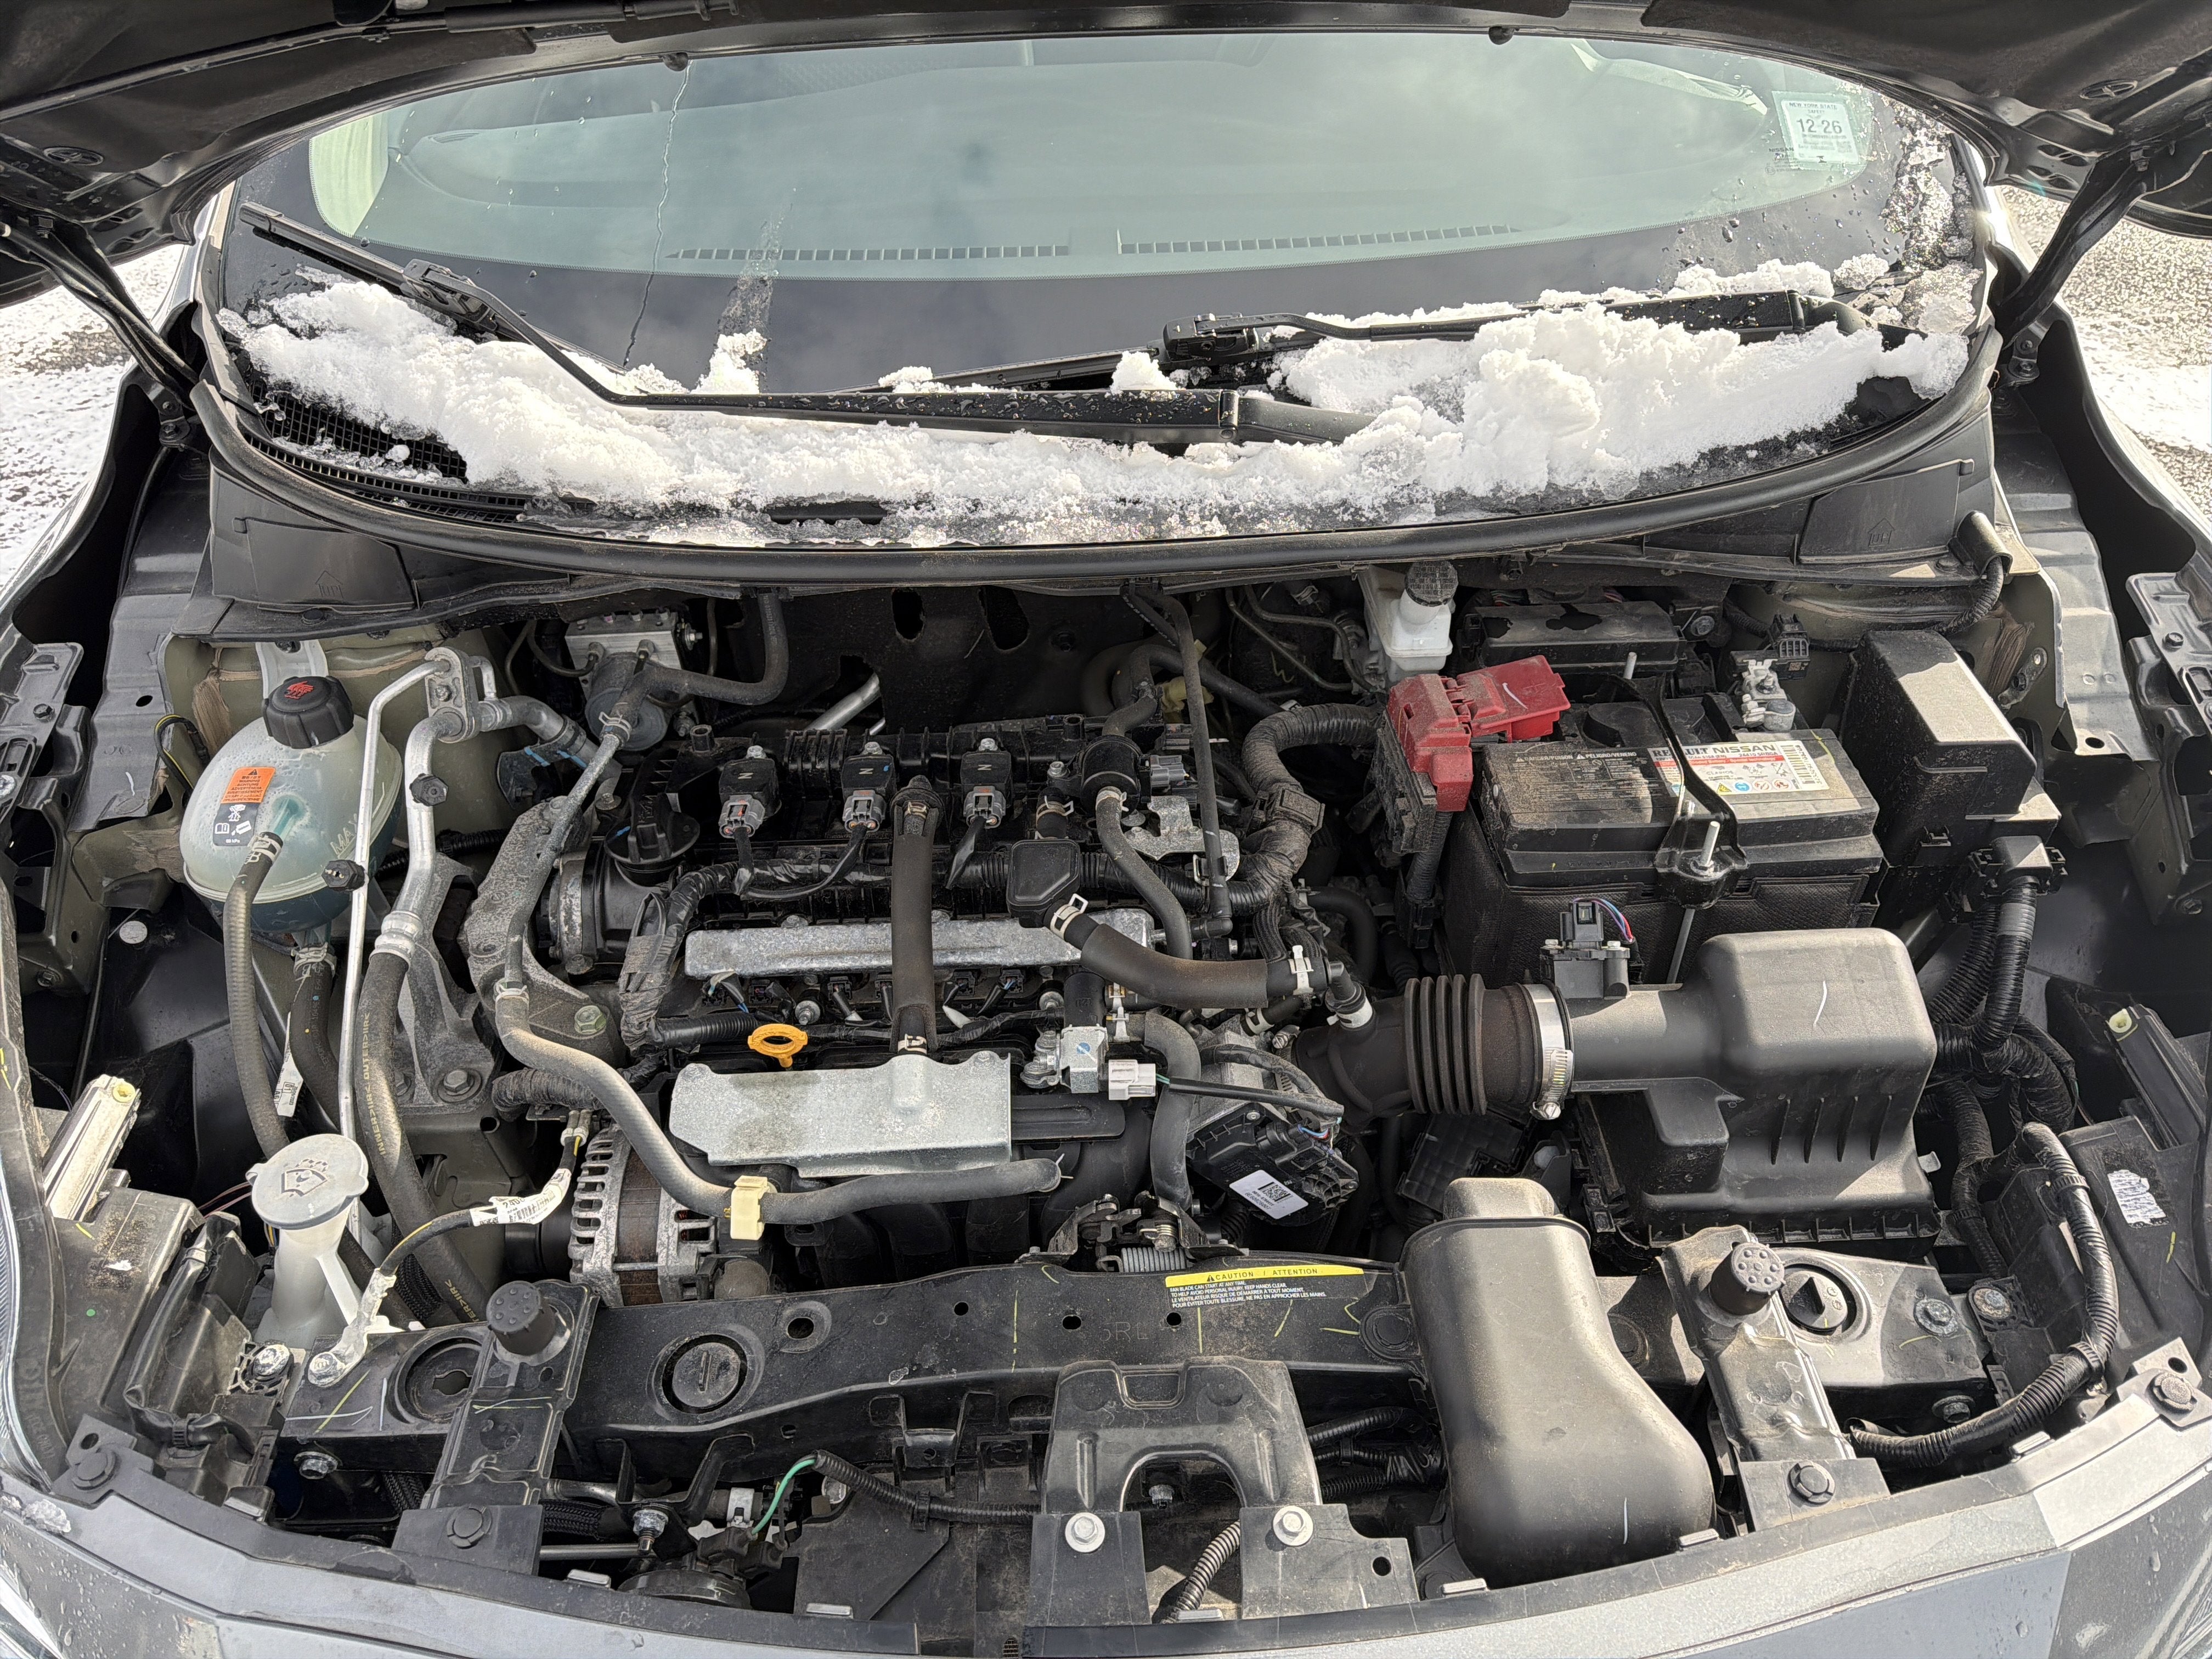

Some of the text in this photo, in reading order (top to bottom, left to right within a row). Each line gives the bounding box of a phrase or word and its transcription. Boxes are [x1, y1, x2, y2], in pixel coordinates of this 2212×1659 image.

[1796, 119, 1842, 134] 12 26
[1652, 744, 1776, 757] REULT NISSAN
[284, 1082, 293, 1092] 01
[1215, 1271, 1254, 1280] CAUTION
